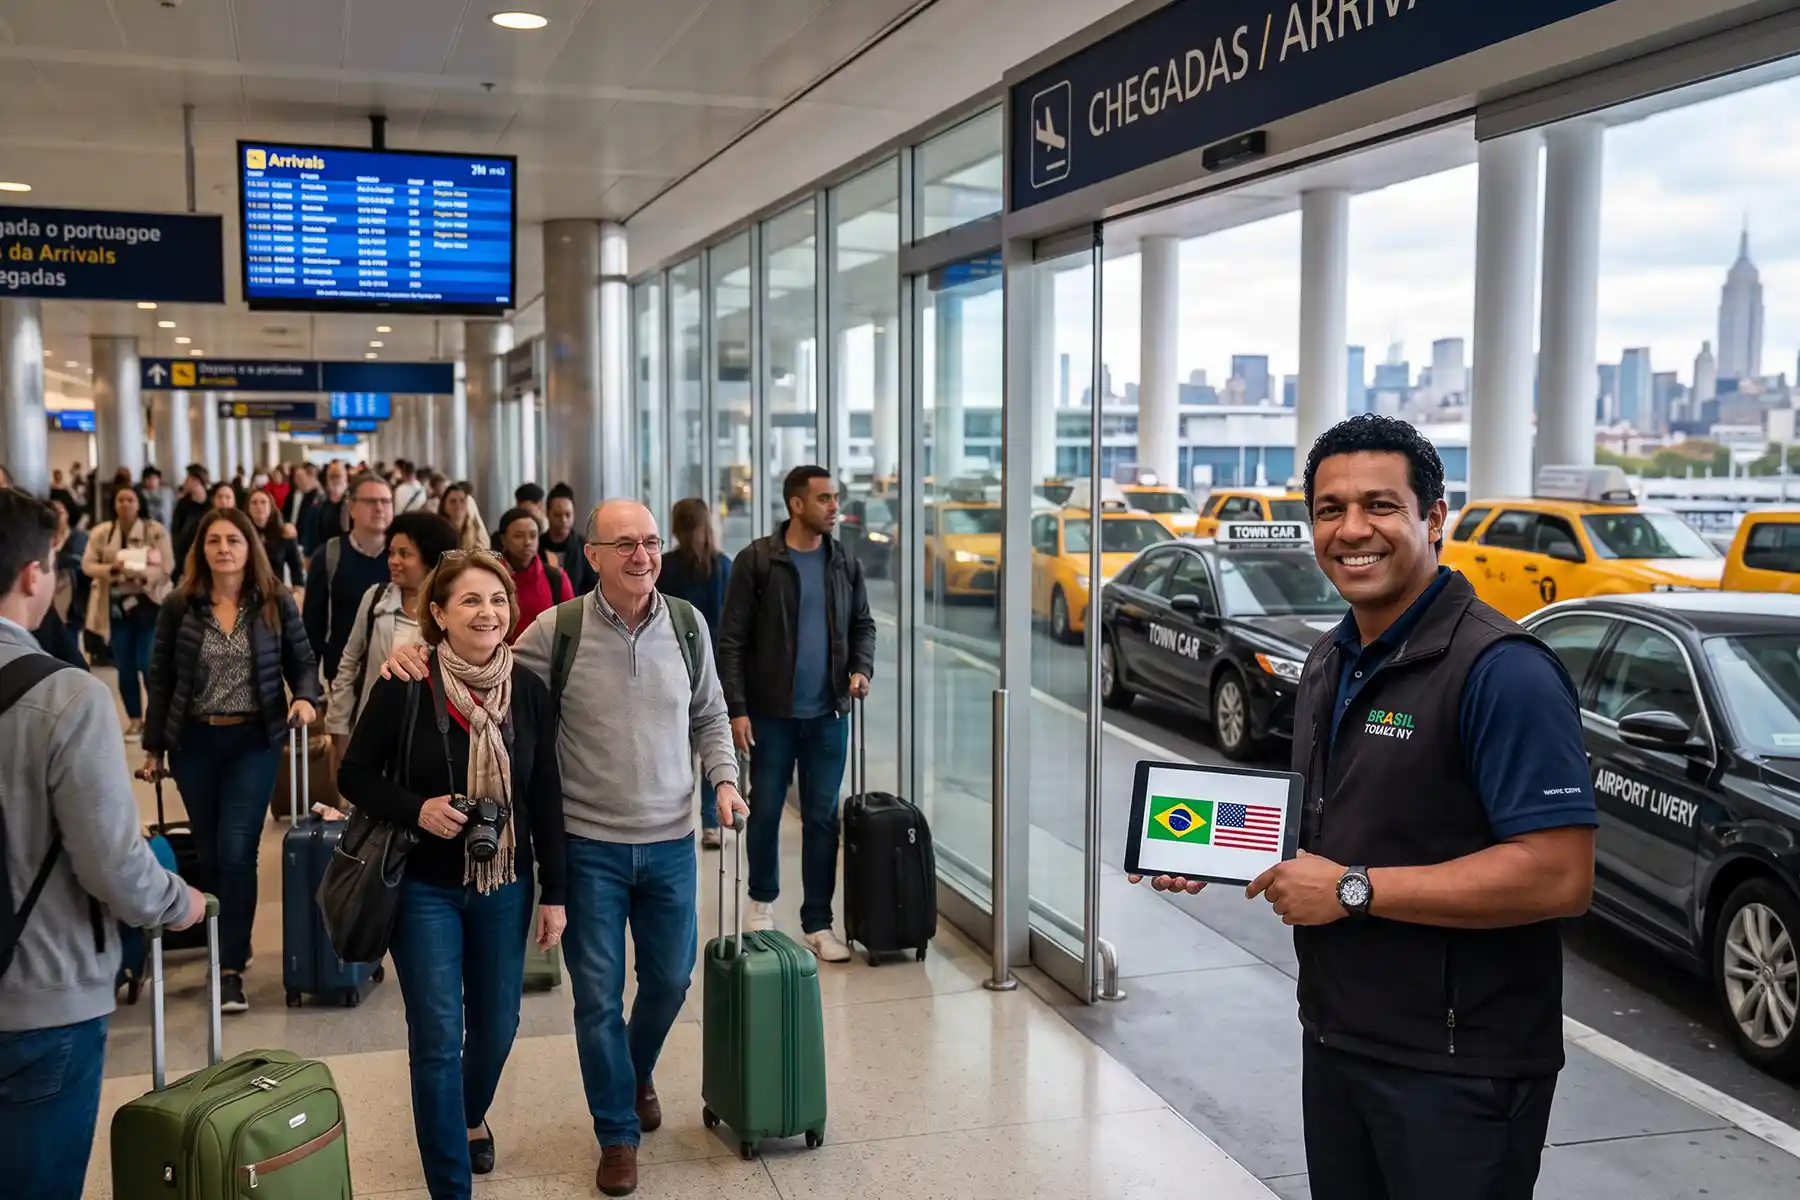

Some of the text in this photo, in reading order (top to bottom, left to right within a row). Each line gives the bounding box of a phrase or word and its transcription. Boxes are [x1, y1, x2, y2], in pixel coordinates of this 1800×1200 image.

[1089, 25, 1249, 137] CHEGADAS
[1279, 0, 1416, 62] ARRI
[268, 153, 325, 170] Arrivals
[46, 223, 58, 238] o
[63, 224, 161, 245] portuagoe
[9, 241, 33, 261] da
[39, 244, 116, 264] Arrivals
[1234, 525, 1296, 539] TOWN CAR
[1150, 622, 1200, 661] TOWN CAR
[1367, 709, 1415, 729] BRASIL
[1396, 728, 1413, 740] NY
[1594, 768, 1698, 828] AIRPORT LIVERY
